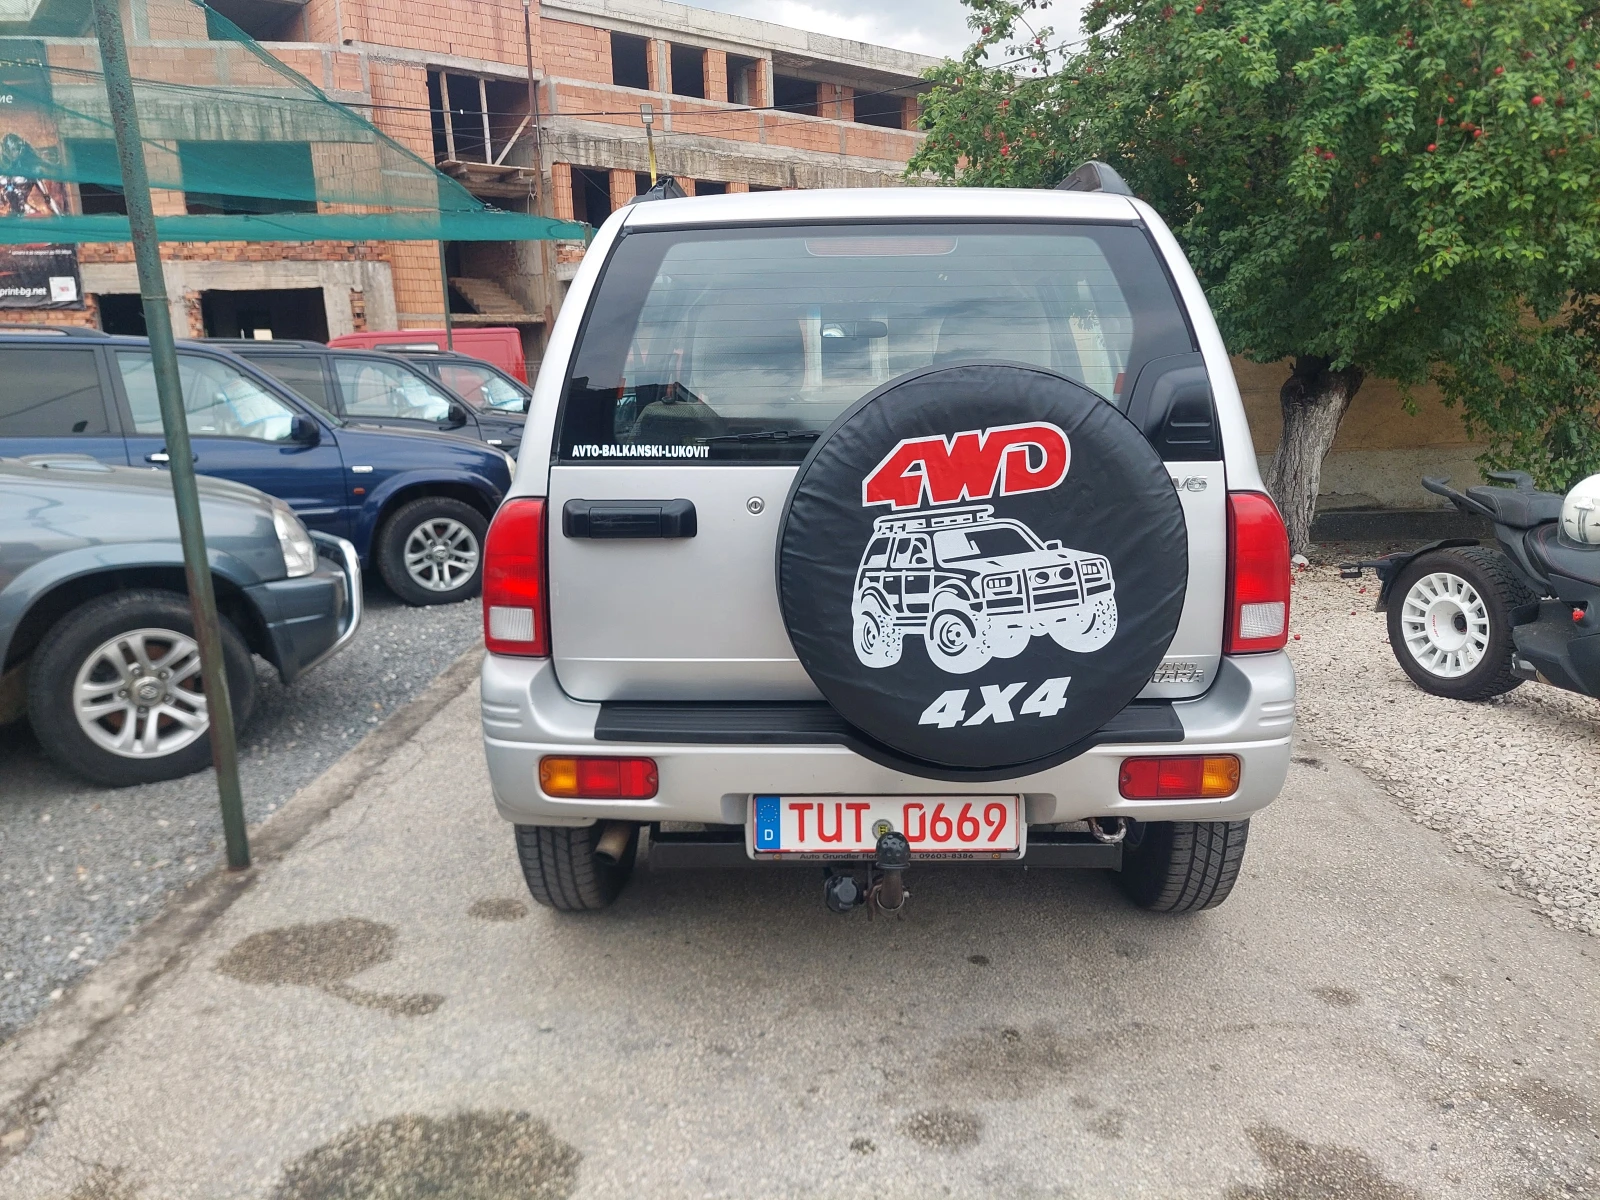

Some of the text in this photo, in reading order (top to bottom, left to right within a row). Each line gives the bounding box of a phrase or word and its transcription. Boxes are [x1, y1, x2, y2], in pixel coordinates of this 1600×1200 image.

[572, 444, 710, 458] AVTO-BALKANSKI-LUKOVIT
[862, 421, 1071, 511] 4WD
[1172, 475, 1208, 492] V6
[1158, 662, 1198, 671] AND
[1151, 670, 1204, 683] TARA
[918, 676, 1071, 728] 4X4
[788, 802, 1008, 843] TUT 0669
[764, 829, 774, 841] D
